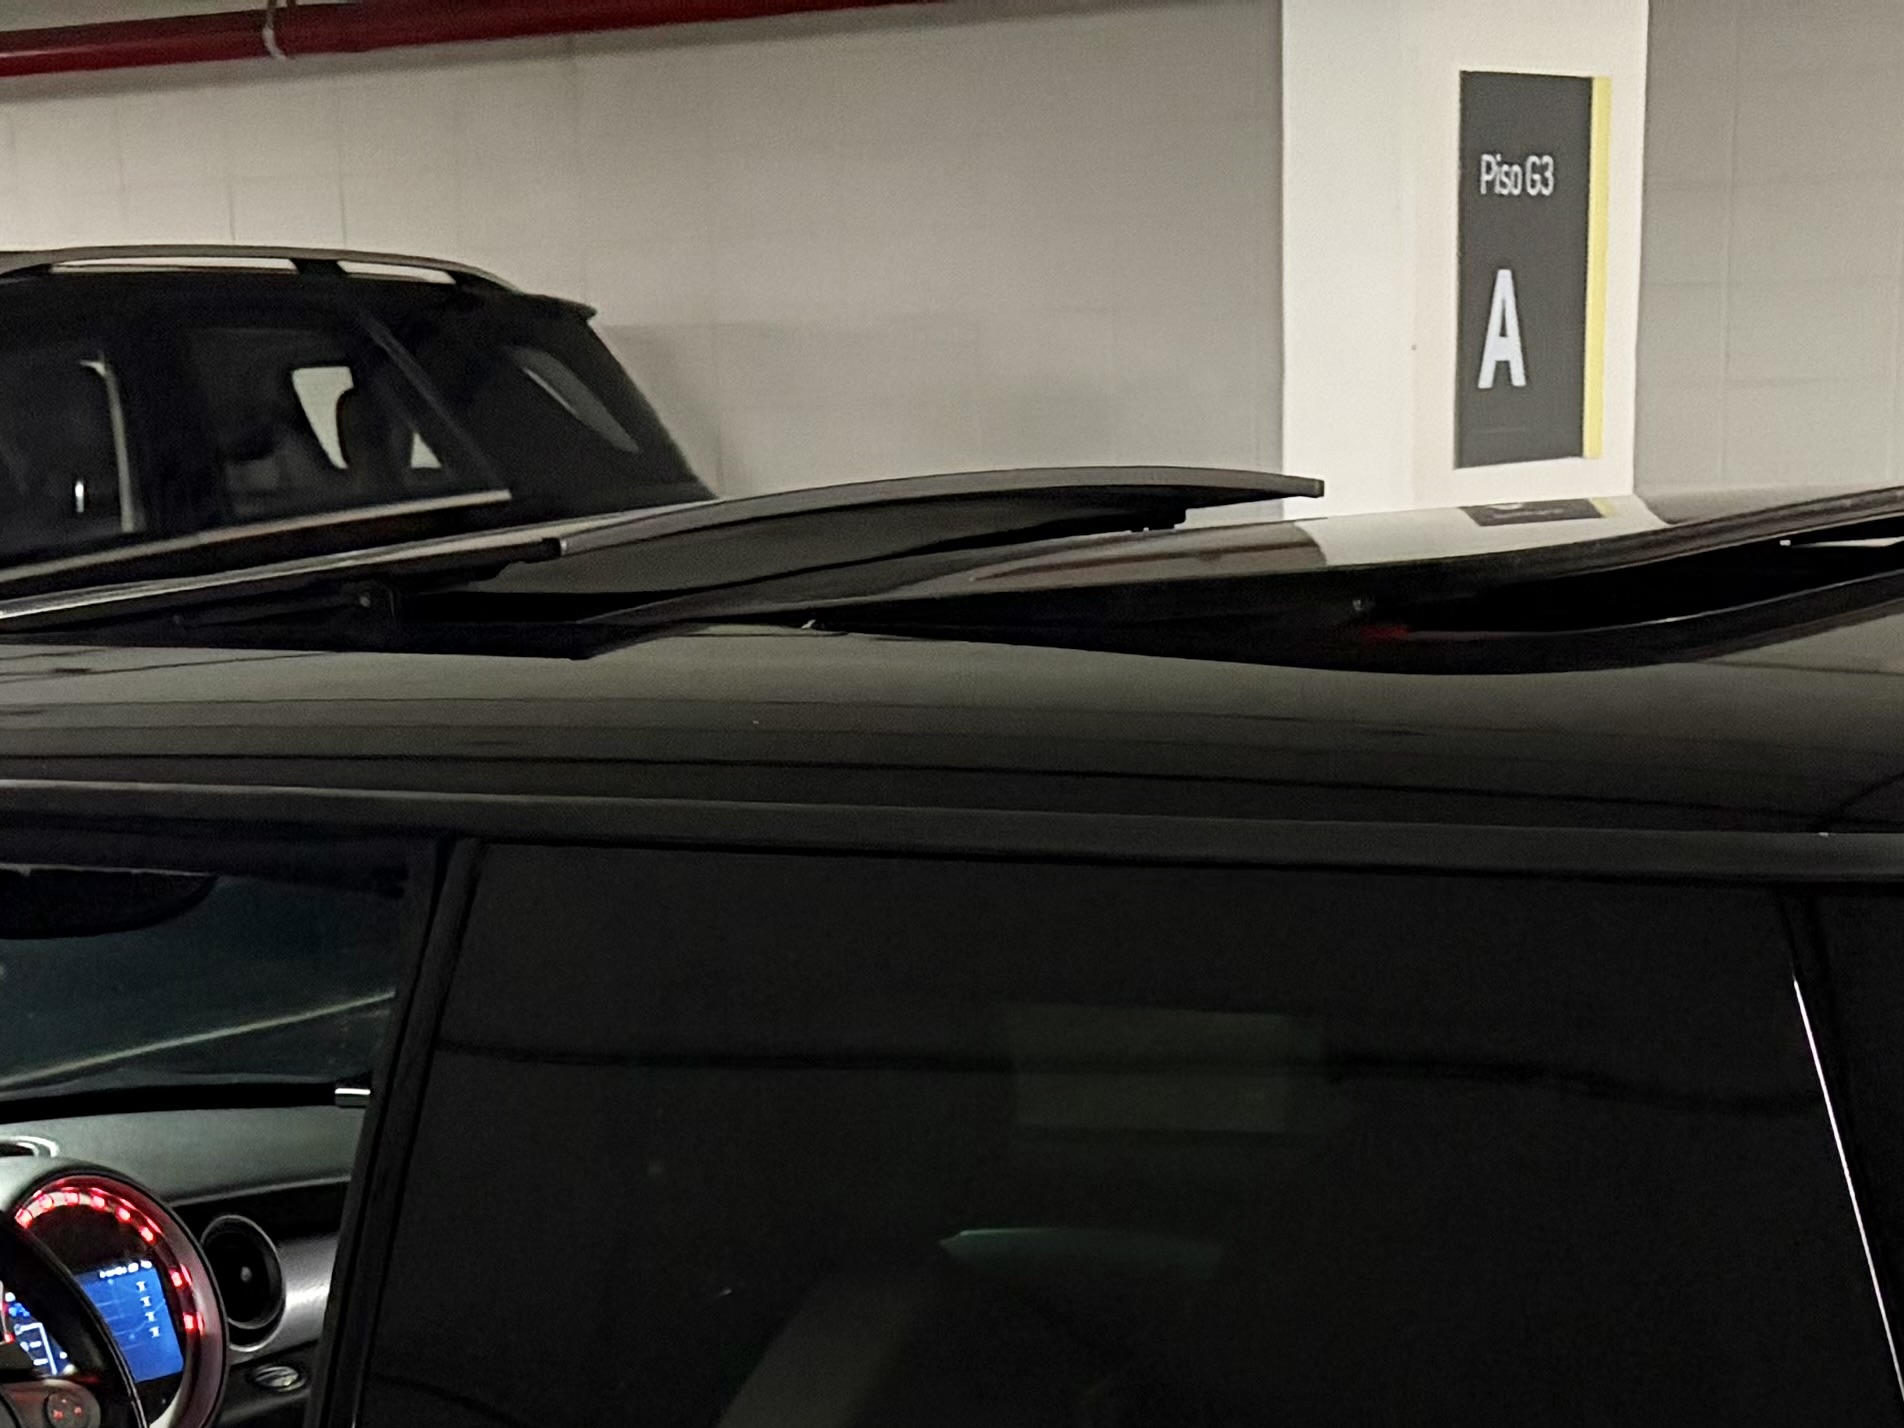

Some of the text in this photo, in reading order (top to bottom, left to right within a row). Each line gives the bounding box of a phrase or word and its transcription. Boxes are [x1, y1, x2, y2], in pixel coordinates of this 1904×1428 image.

[1480, 153, 1554, 196] Piso G3
[1478, 269, 1527, 389] A
